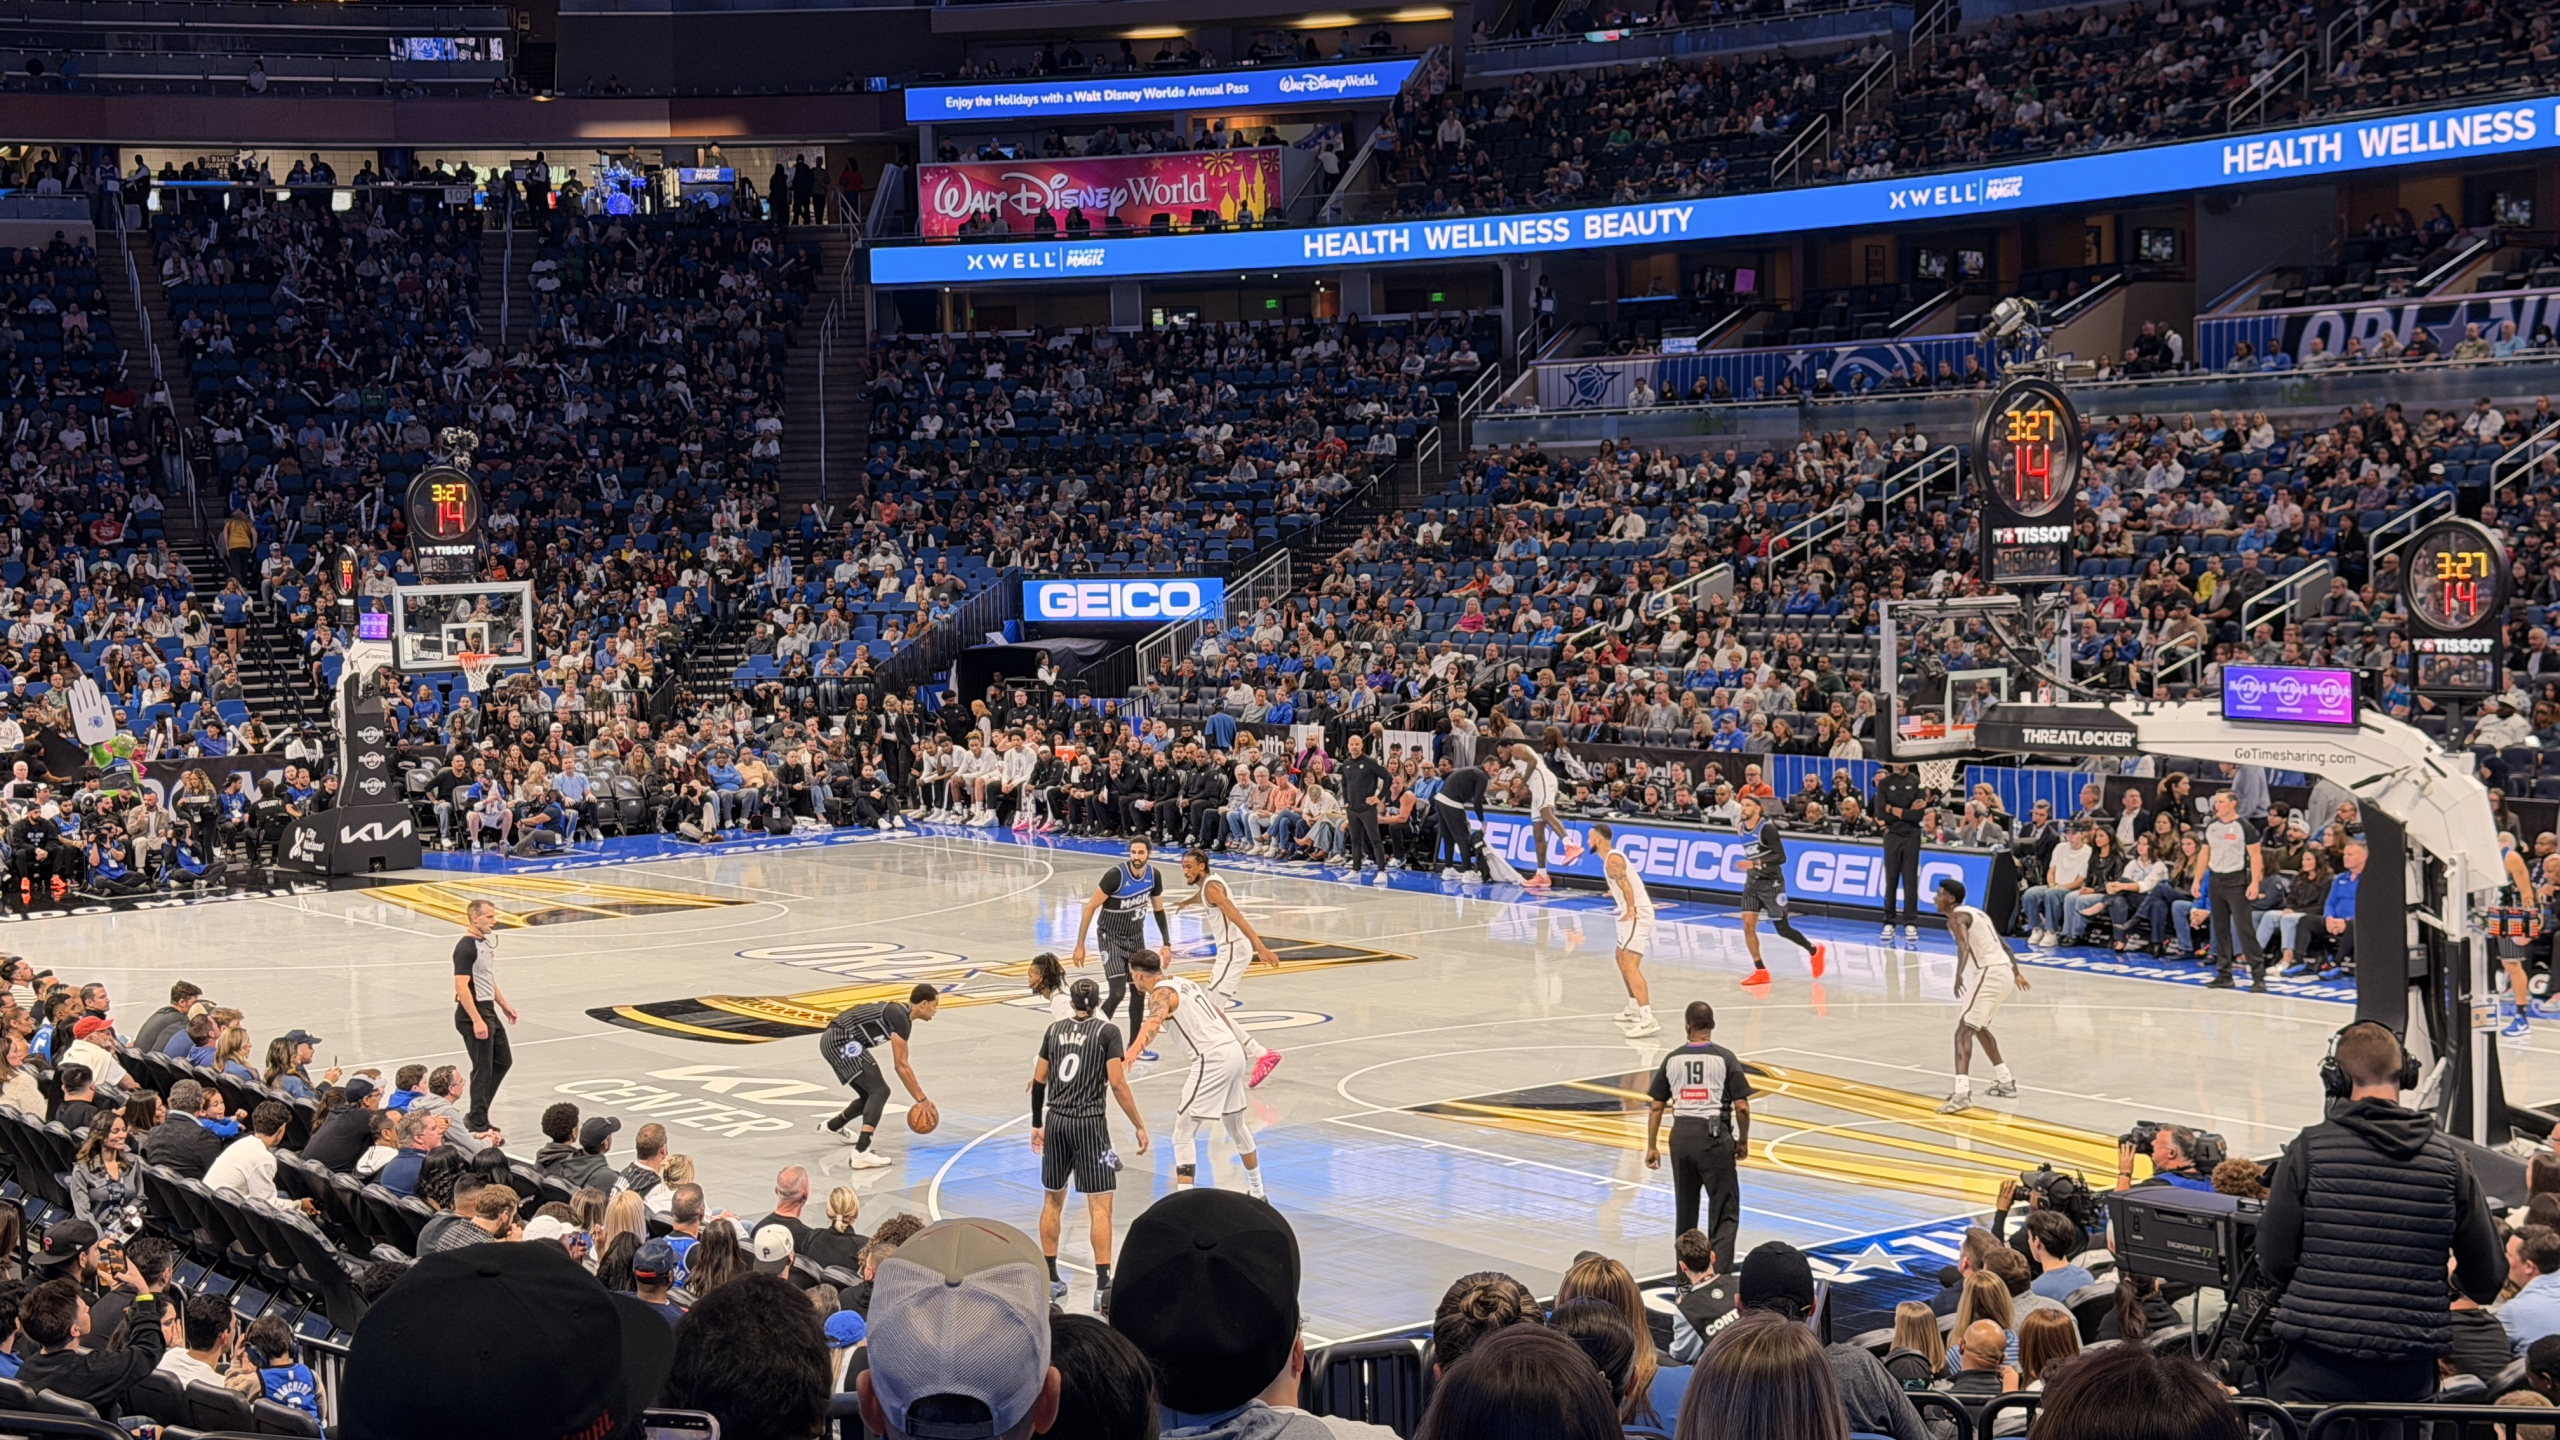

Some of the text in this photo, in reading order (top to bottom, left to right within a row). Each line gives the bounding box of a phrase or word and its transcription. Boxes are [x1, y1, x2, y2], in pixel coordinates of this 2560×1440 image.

[945, 96, 973, 111] Enjoy
[975, 95, 992, 107] the
[994, 93, 1039, 108] Holidays
[1040, 92, 1063, 104] with
[1065, 95, 1073, 103] a
[1073, 89, 1101, 103] Walt
[1103, 88, 1142, 103] Disney
[1187, 83, 1224, 97] Annual
[1226, 82, 1250, 94] Pass
[2223, 131, 2342, 175] HEALTH
[2358, 108, 2536, 159] WELLNESS
[695, 172, 719, 181] MAGIC
[1126, 173, 1208, 206] World
[1889, 183, 1978, 210] XWELL
[1304, 207, 1693, 258] HEALTH WELLNESS BEAUTY
[967, 252, 1105, 272] XWELL MAGIC
[2007, 410, 2054, 441] 3:27
[2015, 444, 2050, 501] 14
[431, 484, 467, 502] 3:27
[438, 501, 466, 535] 14
[2015, 526, 2071, 543] TISSOT
[434, 545, 476, 556] TISSOT
[2437, 552, 2488, 580] 3:27
[1040, 582, 1200, 617] GEICO
[2444, 581, 2476, 617] 14
[2434, 638, 2494, 653] TISSOT
[2022, 728, 2132, 747] THREATLOCKER
[2235, 748, 2356, 765] GoTimesharing.com
[305, 828, 317, 840] City
[341, 819, 411, 844] KIA
[301, 851, 314, 862] Bank
[303, 841, 324, 852] National
[1796, 850, 1963, 904] GEIO
[1120, 892, 1151, 909] MAGIC
[1131, 908, 1147, 922] 35
[1059, 1033, 1087, 1047] BLACK
[1058, 1053, 1080, 1082] 0
[1684, 1061, 1704, 1084] 19
[554, 1078, 794, 1138] CENTER
[762, 1247, 771, 1259] P
[2167, 1240, 2213, 1258] DIGIPOWER 77
